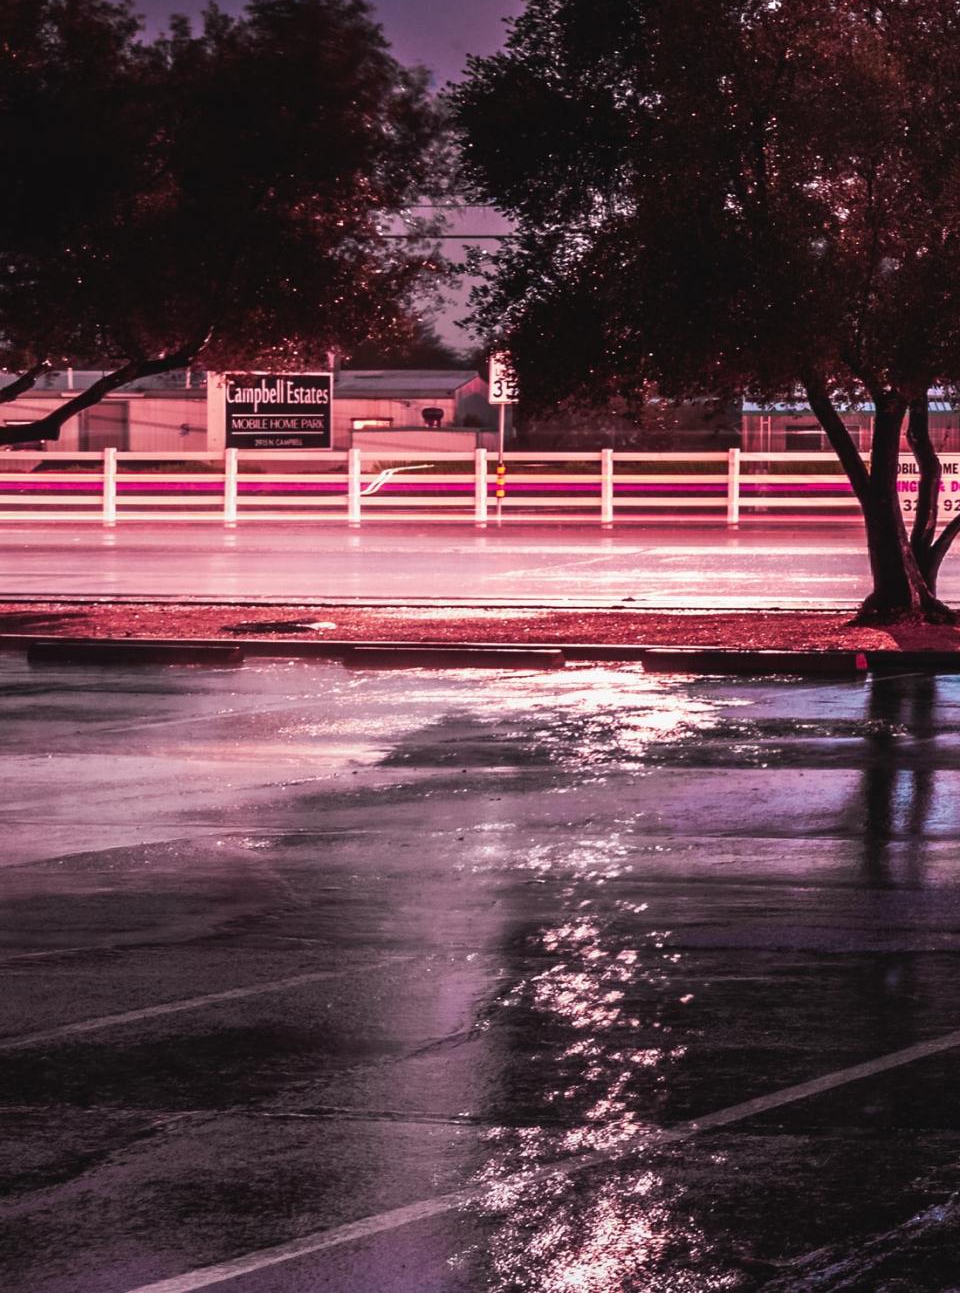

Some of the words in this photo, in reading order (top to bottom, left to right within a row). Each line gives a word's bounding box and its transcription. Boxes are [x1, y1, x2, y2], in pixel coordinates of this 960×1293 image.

[226, 379, 284, 413] Campbell
[286, 380, 329, 404] Estates
[231, 418, 268, 429] MOBILE
[269, 418, 299, 429] HOME
[301, 418, 325, 429] PARK
